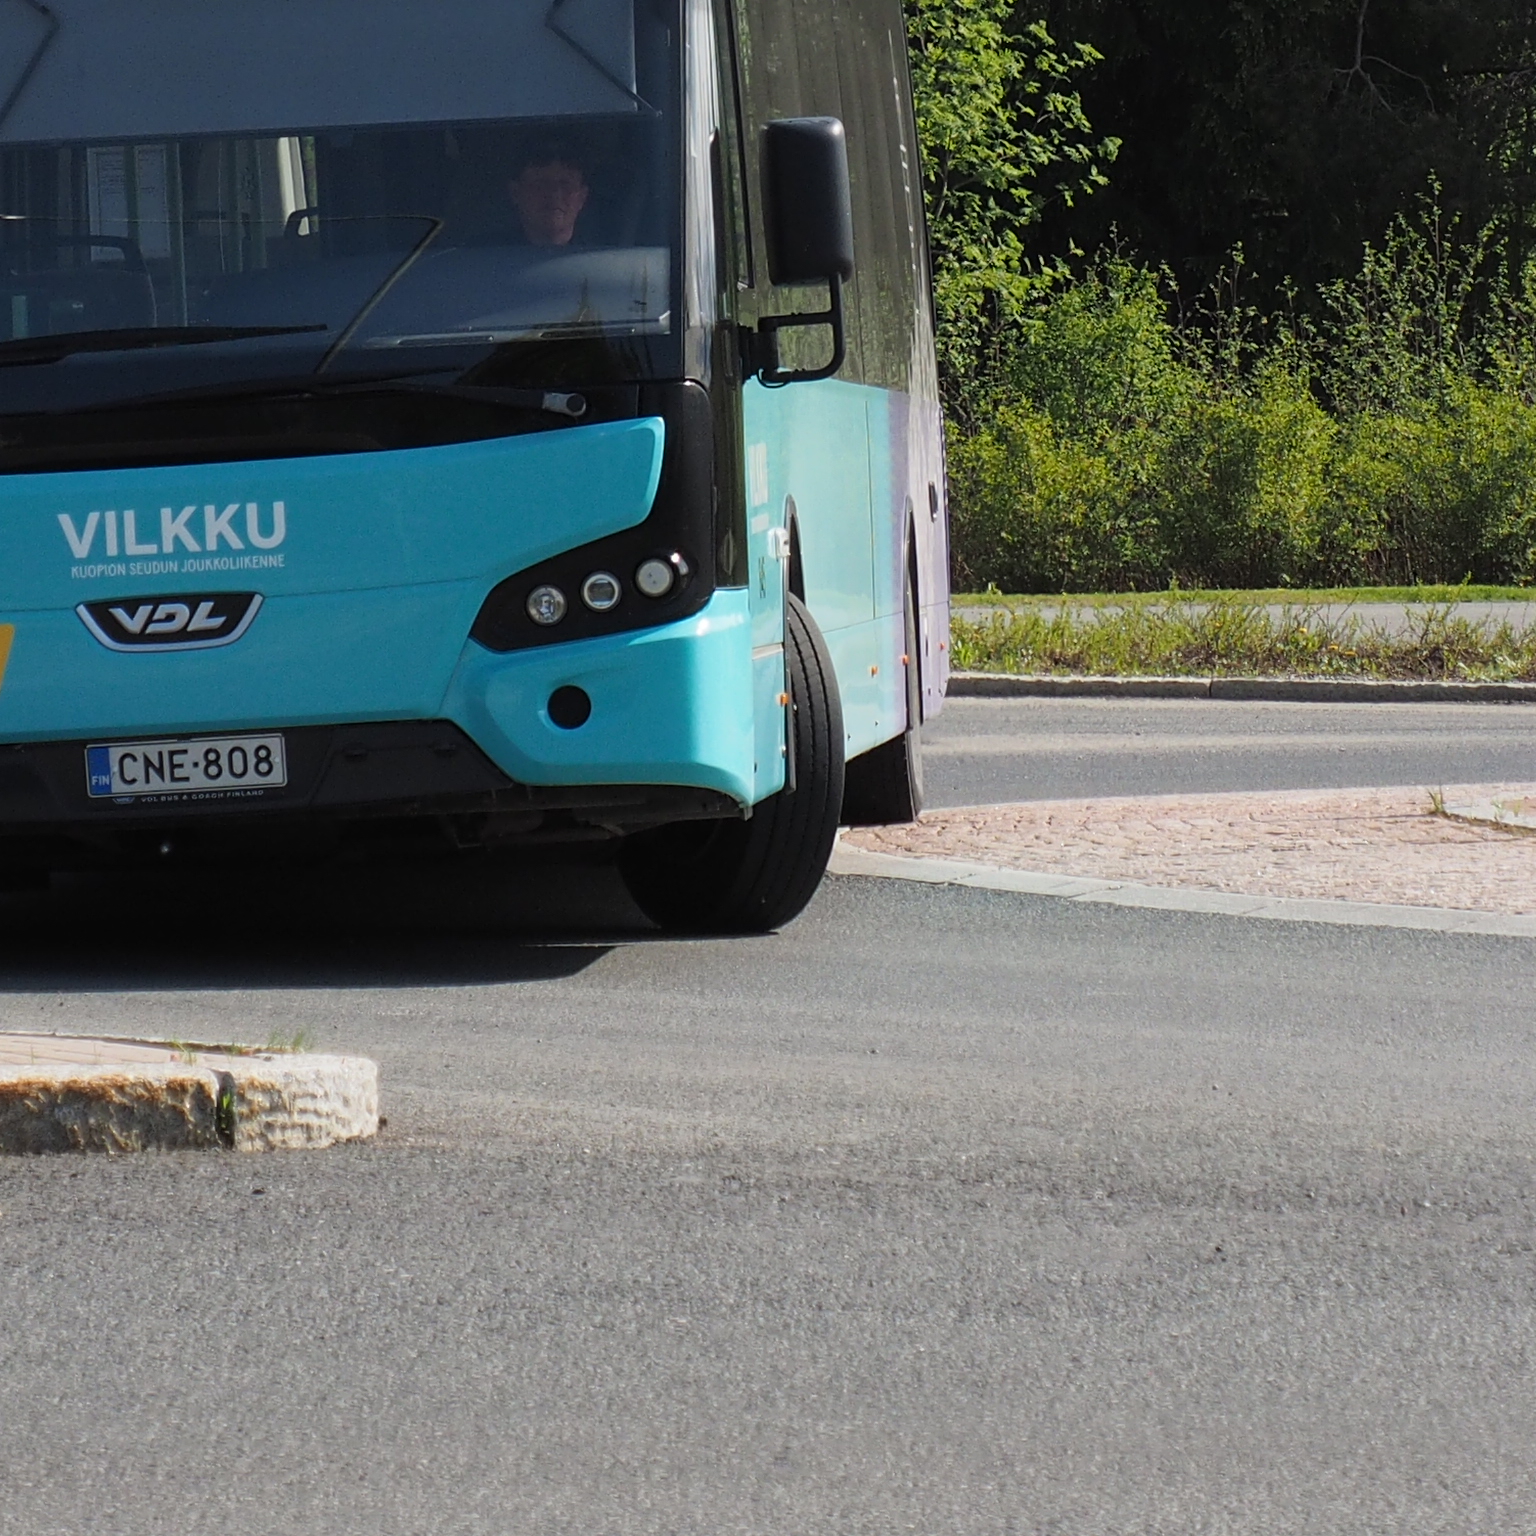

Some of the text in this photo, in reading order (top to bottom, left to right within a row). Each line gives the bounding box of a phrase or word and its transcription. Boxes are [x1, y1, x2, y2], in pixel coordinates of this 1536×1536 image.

[58, 501, 286, 558] VILKKU
[71, 554, 285, 579] KUOPION SEUDUN JOUKKOLIIKENNE
[108, 601, 227, 635] VDL
[91, 745, 274, 786] FIN CNE-808
